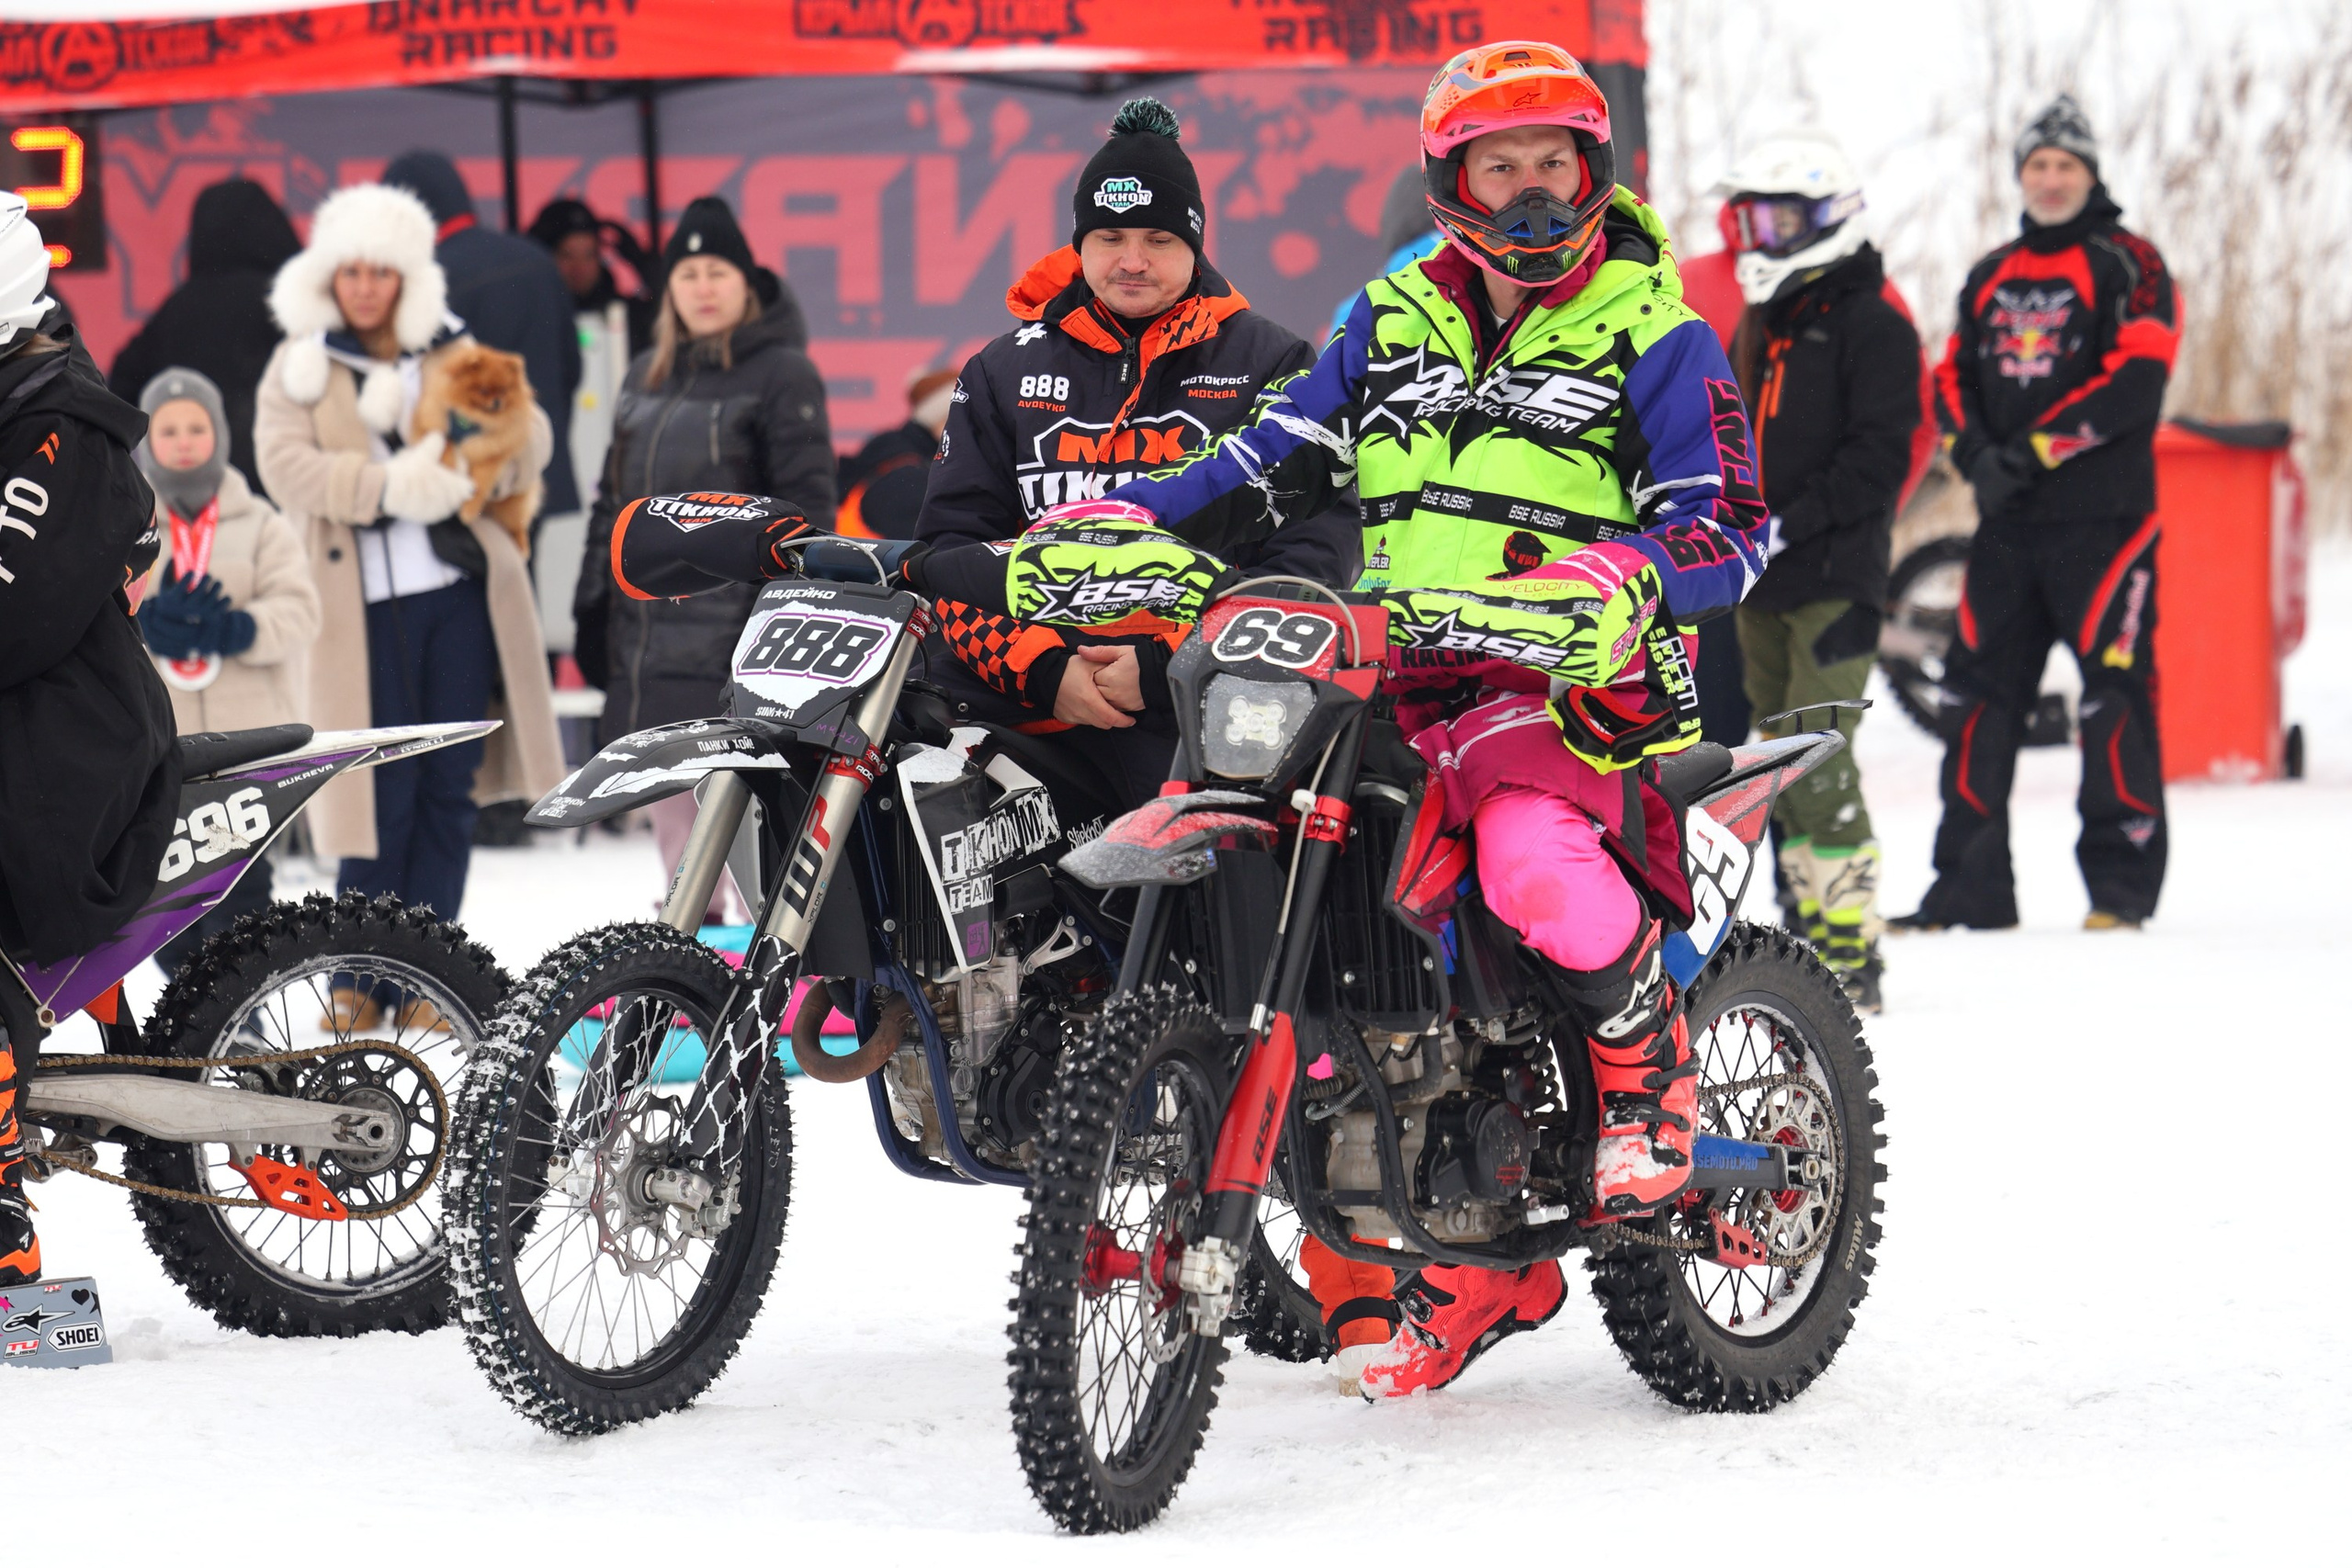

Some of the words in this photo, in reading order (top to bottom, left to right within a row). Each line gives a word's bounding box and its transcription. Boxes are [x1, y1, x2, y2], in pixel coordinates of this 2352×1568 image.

[402, 25, 617, 66] RACING
[1095, 192, 1150, 204] TIKHON
[1106, 181, 1136, 193] MX
[1019, 374, 1070, 400] 888
[1180, 375, 1250, 388] МОТОКРОСС
[1187, 389, 1238, 399] МОСКВА
[1017, 400, 1067, 412] AVDEYKO
[1507, 406, 1581, 434] TEAM
[1057, 424, 1186, 465] MX
[1017, 469, 1147, 501] TIK
[652, 499, 763, 519] TIKHON
[685, 492, 752, 506] MX
[1421, 489, 1441, 504] BSE
[1441, 491, 1473, 511] RUSSIA
[1509, 504, 1530, 523] BSE
[1530, 508, 1566, 529] RUSSIA
[1078, 532, 1093, 542] BSE
[1093, 534, 1119, 546] RUSSIA
[1596, 525, 1614, 540] BSE
[762, 586, 837, 600] АВДЕЙКО
[1069, 578, 1187, 607] BSE
[1501, 581, 1589, 593] VELOCITY
[1139, 598, 1176, 609] TEAM
[739, 615, 888, 682] 888
[1212, 607, 1337, 669] 69
[1437, 633, 1570, 669] BSE
[696, 739, 729, 752] ПАНКИ
[732, 736, 755, 750] ХОЙ!
[1015, 786, 1061, 856] MX
[157, 786, 271, 883] 696
[949, 874, 993, 914] TEAM
[808, 891, 823, 924] XPLOR
[1845, 1213, 1864, 1272] Mitas
[56, 1327, 99, 1347] SHOEI
